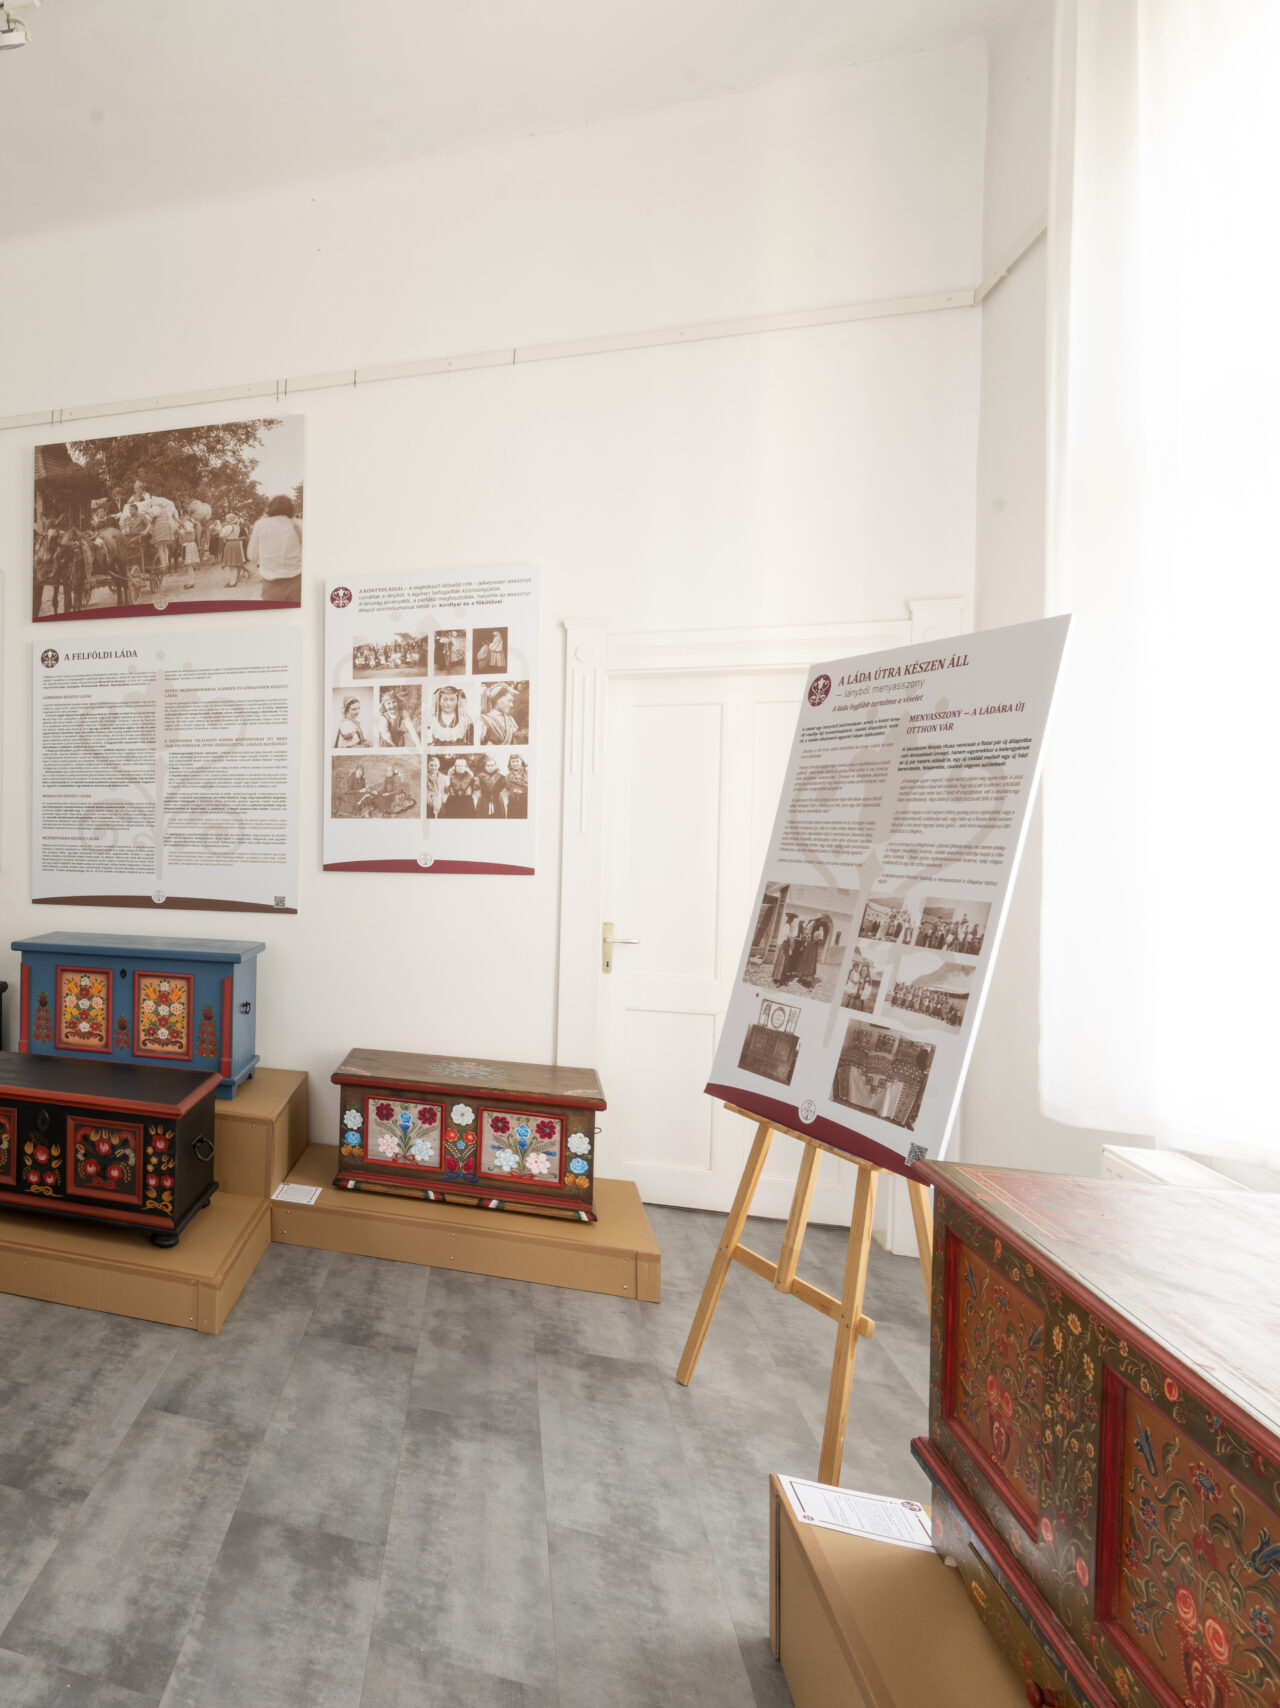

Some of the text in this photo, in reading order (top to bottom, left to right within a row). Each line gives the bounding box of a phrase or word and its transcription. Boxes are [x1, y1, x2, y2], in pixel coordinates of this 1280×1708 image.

[64, 648, 138, 661] A FELFÖLDI LÁDA
[838, 654, 970, 686] A LÁDA ÚTRA KÉSZEN ÁLL
[844, 686, 871, 699] lányból
[871, 678, 926, 694] menyasszony
[838, 703, 849, 712] láda
[871, 698, 896, 709] tartalma
[903, 694, 924, 704] viselet
[908, 709, 963, 722] MENYASSZONY
[979, 703, 1013, 715] LÁDÁRA
[1015, 700, 1026, 712] ÚJ
[906, 722, 954, 735] OTTHON VÁR
